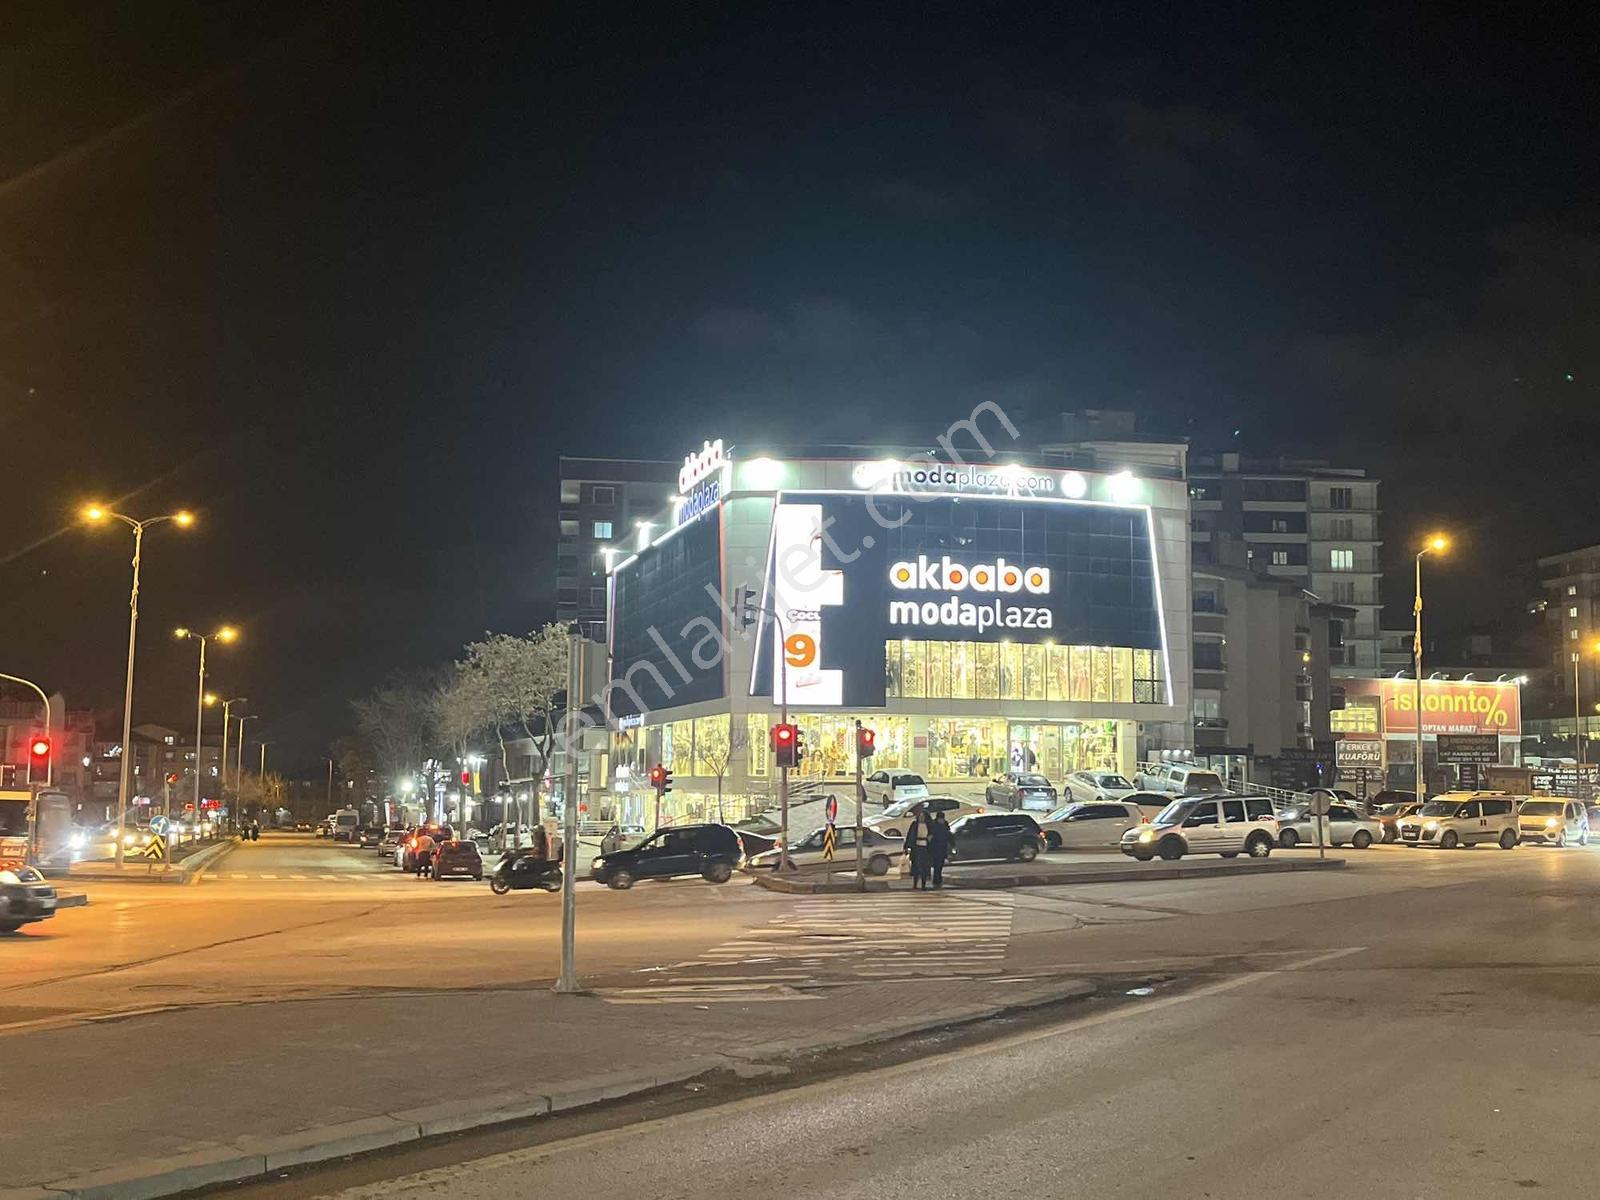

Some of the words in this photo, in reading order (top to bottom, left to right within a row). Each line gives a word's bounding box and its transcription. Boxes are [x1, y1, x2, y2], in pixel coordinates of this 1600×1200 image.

[893, 465, 1053, 490] modaplazacom
[889, 555, 1050, 594] akbaba
[889, 596, 1053, 634] modaplaza
[785, 634, 816, 667] 9
[1338, 752, 1380, 761] KUAFÖRÜ
[1346, 743, 1371, 751] ERKEK
